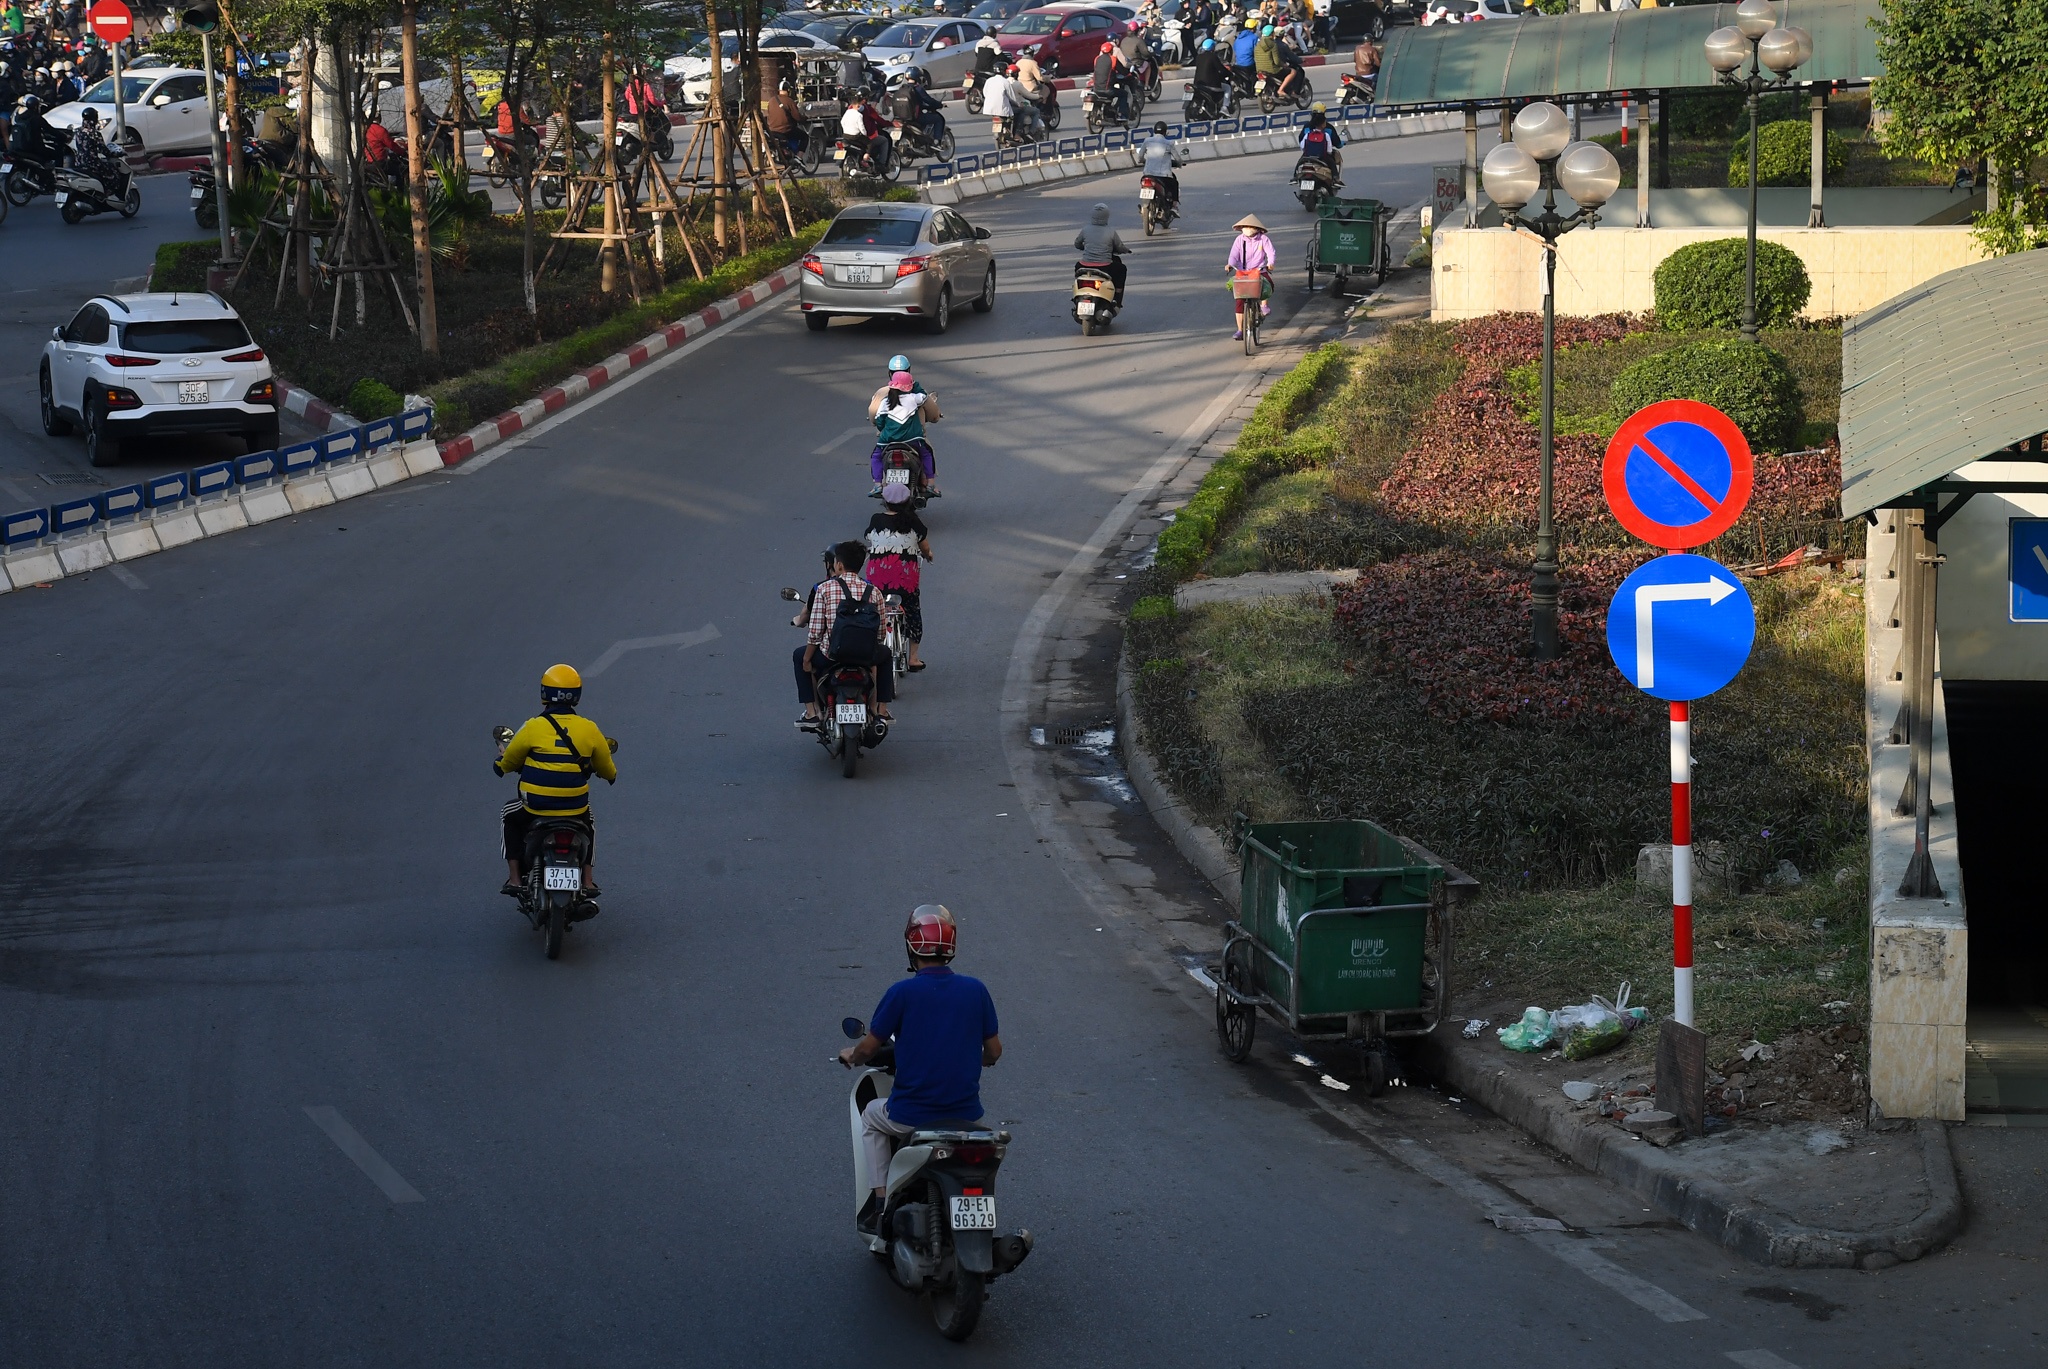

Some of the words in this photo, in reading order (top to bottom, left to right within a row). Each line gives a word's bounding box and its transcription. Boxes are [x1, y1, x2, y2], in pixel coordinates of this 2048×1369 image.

[852, 266, 866, 274] 30A
[847, 275, 870, 283] 619.12
[185, 383, 201, 392] 30F
[180, 393, 208, 402] 575.35
[557, 690, 573, 700] be
[840, 705, 861, 713] 89-B1
[838, 714, 865, 722] 042.94
[550, 869, 574, 878] 37-L1
[547, 879, 578, 888] 407.78
[957, 1198, 989, 1212] 29-E1
[954, 1213, 995, 1227] 963.29
